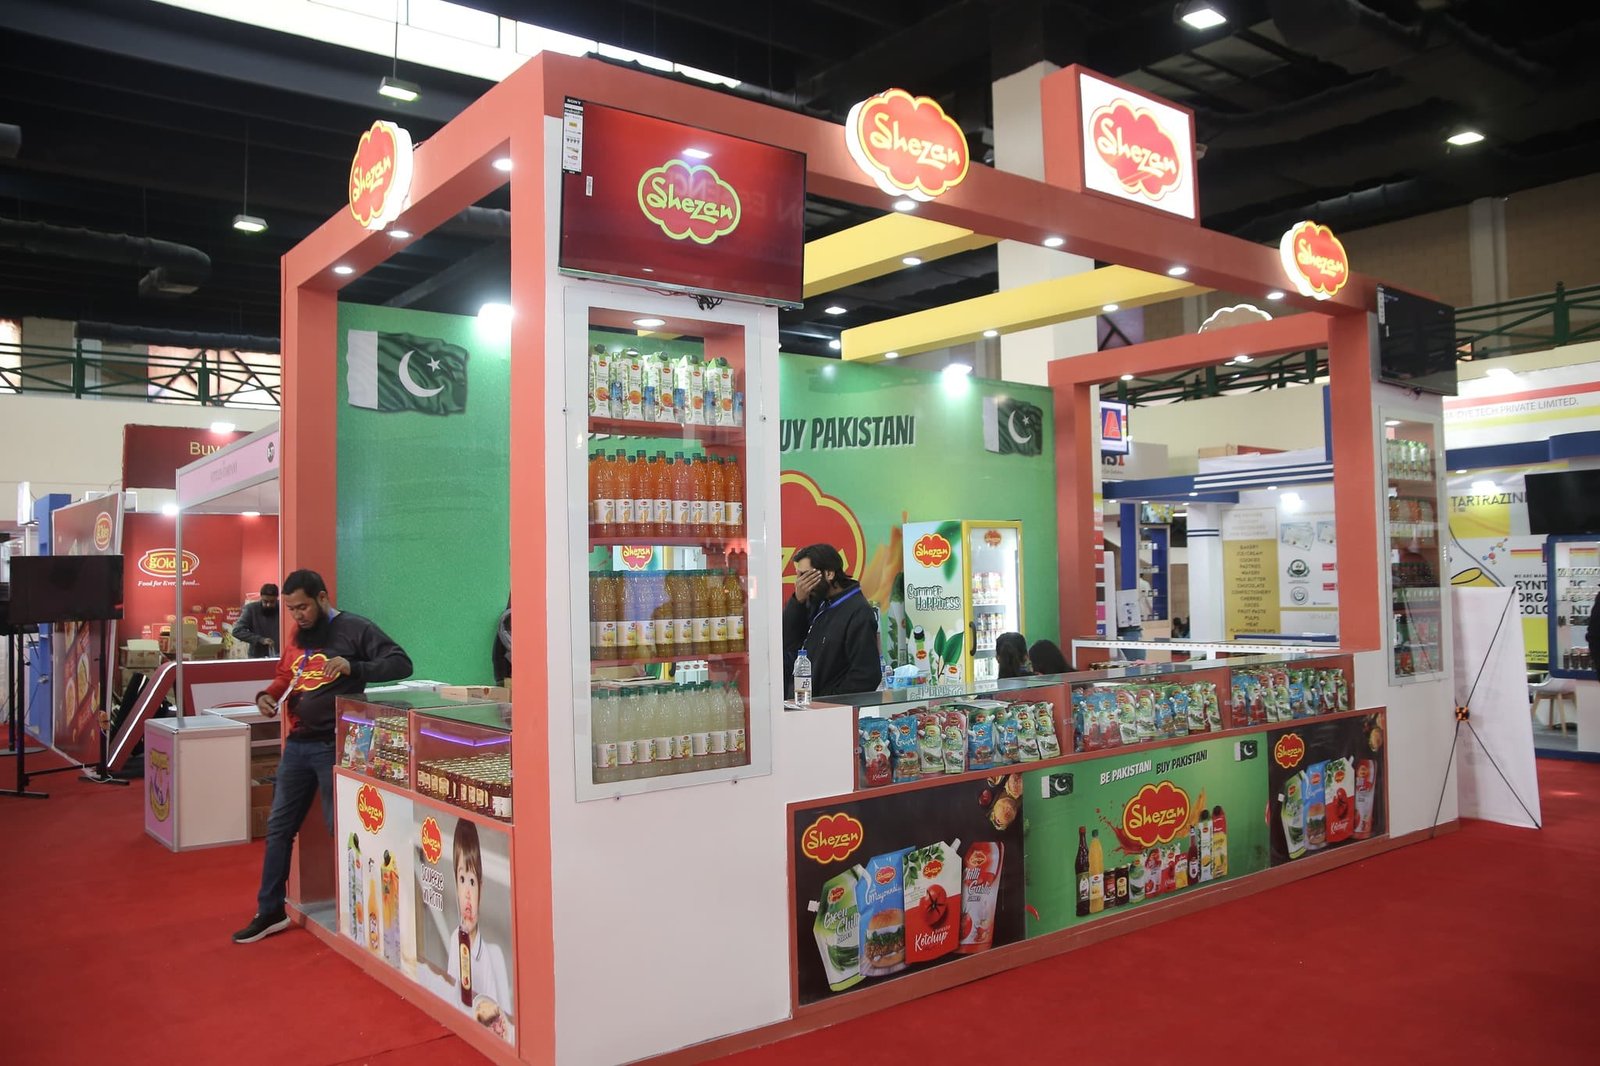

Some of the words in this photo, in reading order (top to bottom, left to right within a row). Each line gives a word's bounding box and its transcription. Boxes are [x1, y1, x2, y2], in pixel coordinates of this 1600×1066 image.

[869, 112, 961, 170] Shezan
[1097, 117, 1177, 178] Shezan
[352, 156, 391, 203] Shezan
[646, 176, 733, 224] Shezan
[1297, 239, 1345, 277] Shezan
[1501, 402, 1535, 413] PRIVATE
[780, 419, 806, 451] UY
[811, 415, 915, 449] PAKISTANI
[1451, 491, 1528, 507] TARTRAZIN
[916, 543, 948, 558] Shezan
[1277, 744, 1302, 758] Shezan
[1100, 771, 1110, 785] BE
[1111, 760, 1152, 781] PAKISTANI
[1156, 762, 1170, 775] BUY
[1171, 750, 1207, 770] PAKISTANI
[358, 796, 383, 821] Shezan
[1129, 804, 1185, 829] Shezan
[422, 830, 441, 851] Shezan
[807, 830, 858, 849] Shezan
[914, 930, 949, 952] Ketchup
